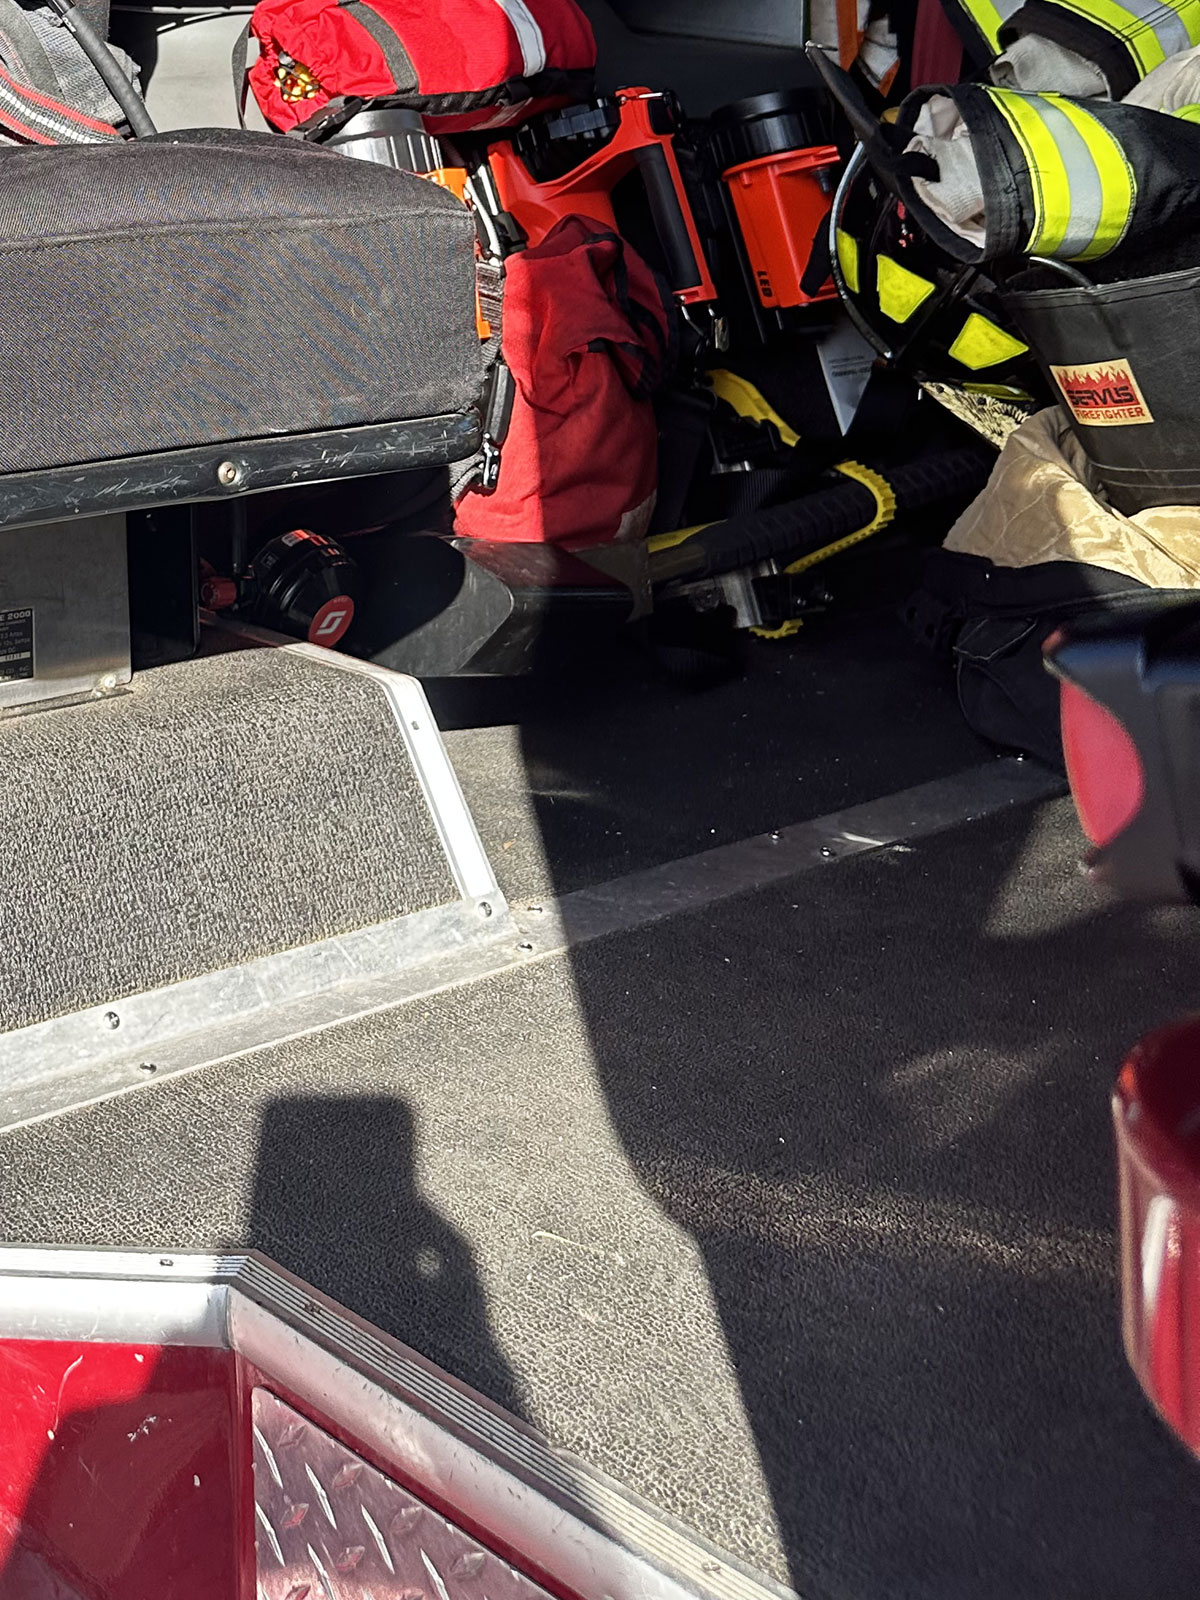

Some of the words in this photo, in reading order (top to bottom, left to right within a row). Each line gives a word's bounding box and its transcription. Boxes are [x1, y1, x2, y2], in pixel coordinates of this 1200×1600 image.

[756, 270, 773, 297] LED
[1066, 386, 1135, 406] SERVUS
[1074, 407, 1146, 420] FIREFIGHTER
[7, 610, 31, 620] 2000
